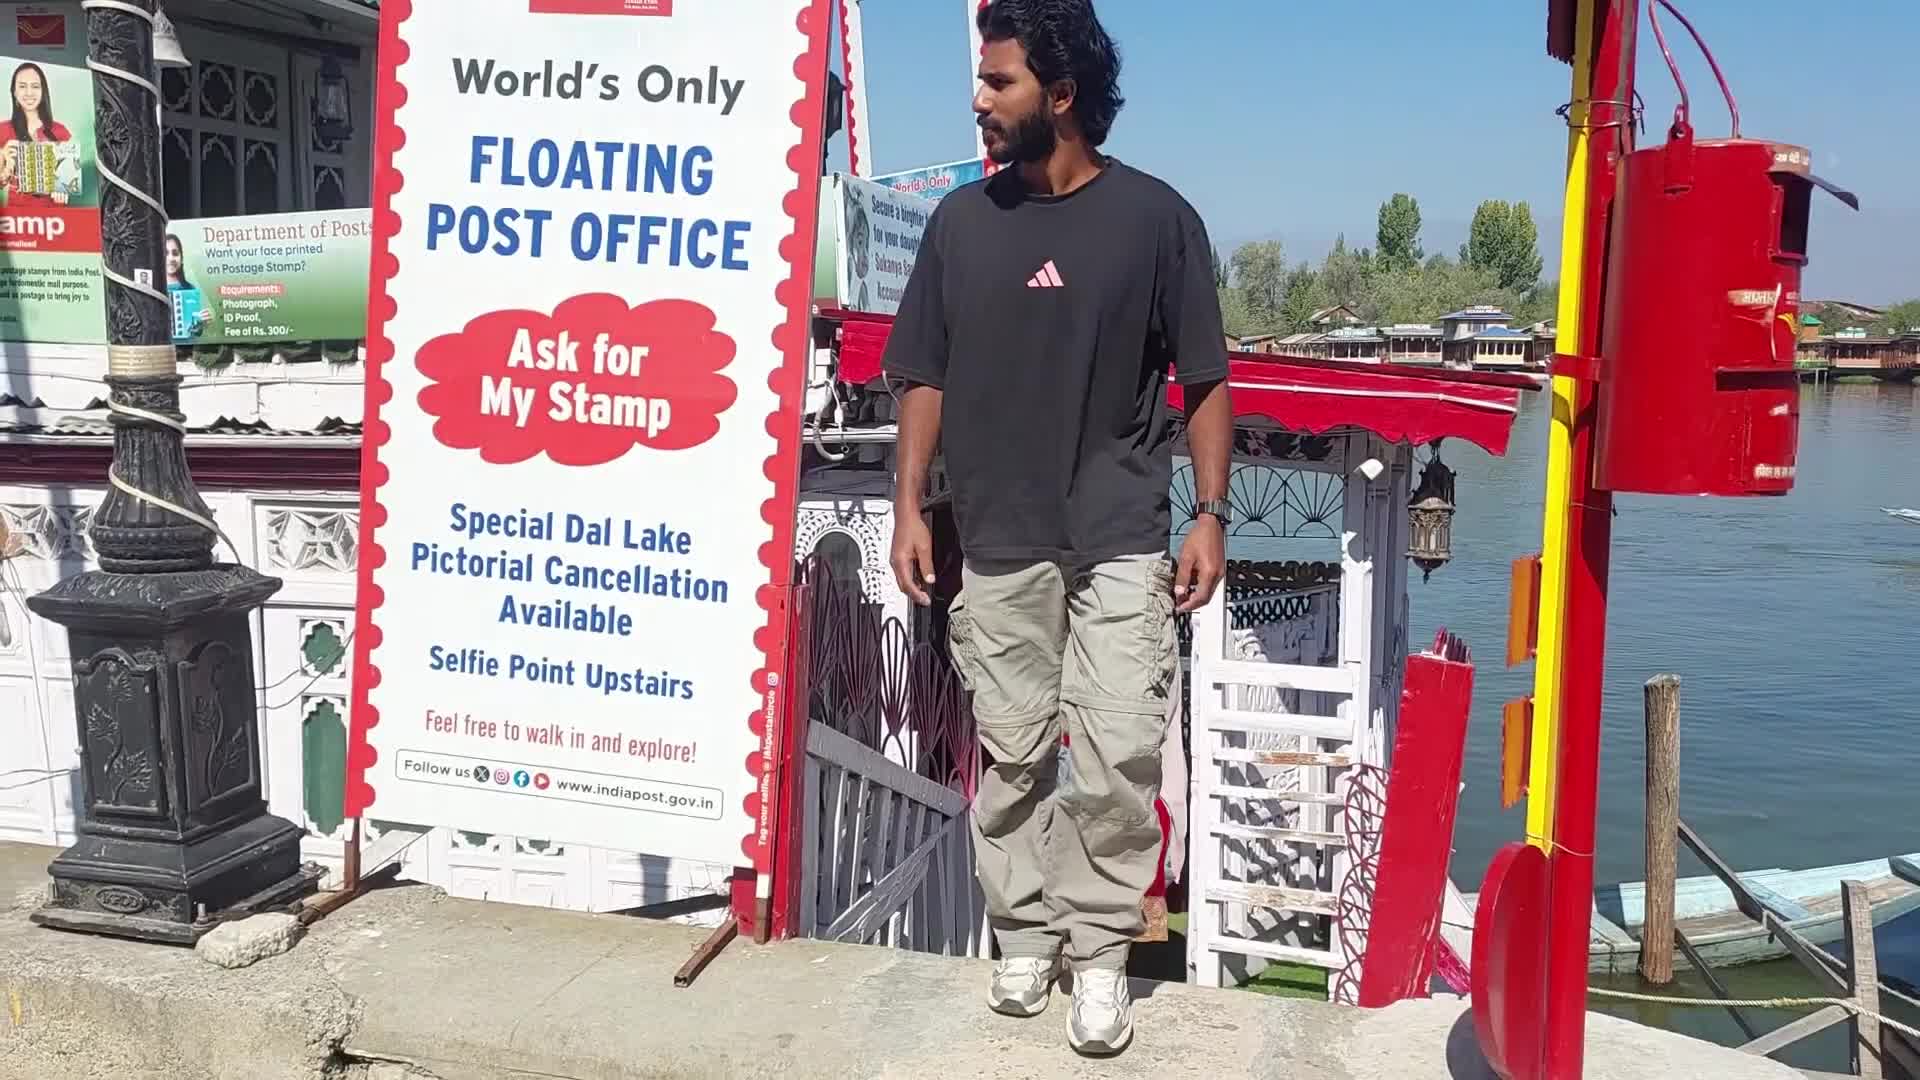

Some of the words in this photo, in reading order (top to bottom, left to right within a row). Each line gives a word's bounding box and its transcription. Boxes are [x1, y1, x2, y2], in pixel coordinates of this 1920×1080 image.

[453, 57, 620, 101] World's
[637, 65, 745, 116] Only
[469, 135, 714, 196] FLOATING
[929, 175, 952, 188] Only
[871, 194, 894, 219] Secure
[895, 207, 900, 220] a
[203, 225, 306, 247] Department
[311, 220, 327, 237] of
[427, 203, 553, 258] POST
[570, 212, 752, 271] OFFICE
[873, 223, 883, 243] for
[885, 231, 898, 248] your
[205, 247, 233, 259] Want
[235, 247, 258, 260] your
[259, 245, 283, 256] face
[285, 243, 324, 256] printed
[28, 266, 50, 278] stamps
[52, 267, 67, 276] from
[68, 267, 84, 277] India
[207, 265, 220, 275] on
[222, 261, 264, 275] Postage
[266, 260, 307, 274] Stamp?
[47, 280, 61, 288] mail
[220, 284, 281, 296] Requirements:
[223, 298, 278, 310] Photograph,
[224, 312, 233, 323] ID
[235, 312, 262, 323] Proof,
[225, 326, 241, 337] Fee
[242, 326, 252, 336] of
[253, 326, 267, 336] Rs.
[268, 325, 295, 336] 300/-
[507, 327, 579, 373] Ask
[593, 332, 649, 377] for
[480, 374, 536, 428] My
[548, 381, 672, 437] Stamp
[450, 502, 553, 541] Special
[565, 513, 611, 547] Dal
[624, 518, 692, 555] Lake
[411, 542, 533, 583] Pictorial
[544, 555, 729, 604] Cancellation
[498, 594, 633, 636] Available
[429, 645, 499, 677] Selfie
[509, 653, 576, 687] Point
[586, 662, 694, 700] Upstairs
[425, 709, 458, 735] Feel
[464, 713, 498, 739] free
[503, 719, 521, 741] to
[525, 718, 565, 747] walk
[570, 725, 585, 750] in
[591, 727, 623, 754] and
[628, 732, 697, 764] explore!
[404, 758, 451, 777] Follow
[455, 766, 471, 780] us
[556, 777, 714, 810] www.indiapost.gov.in
